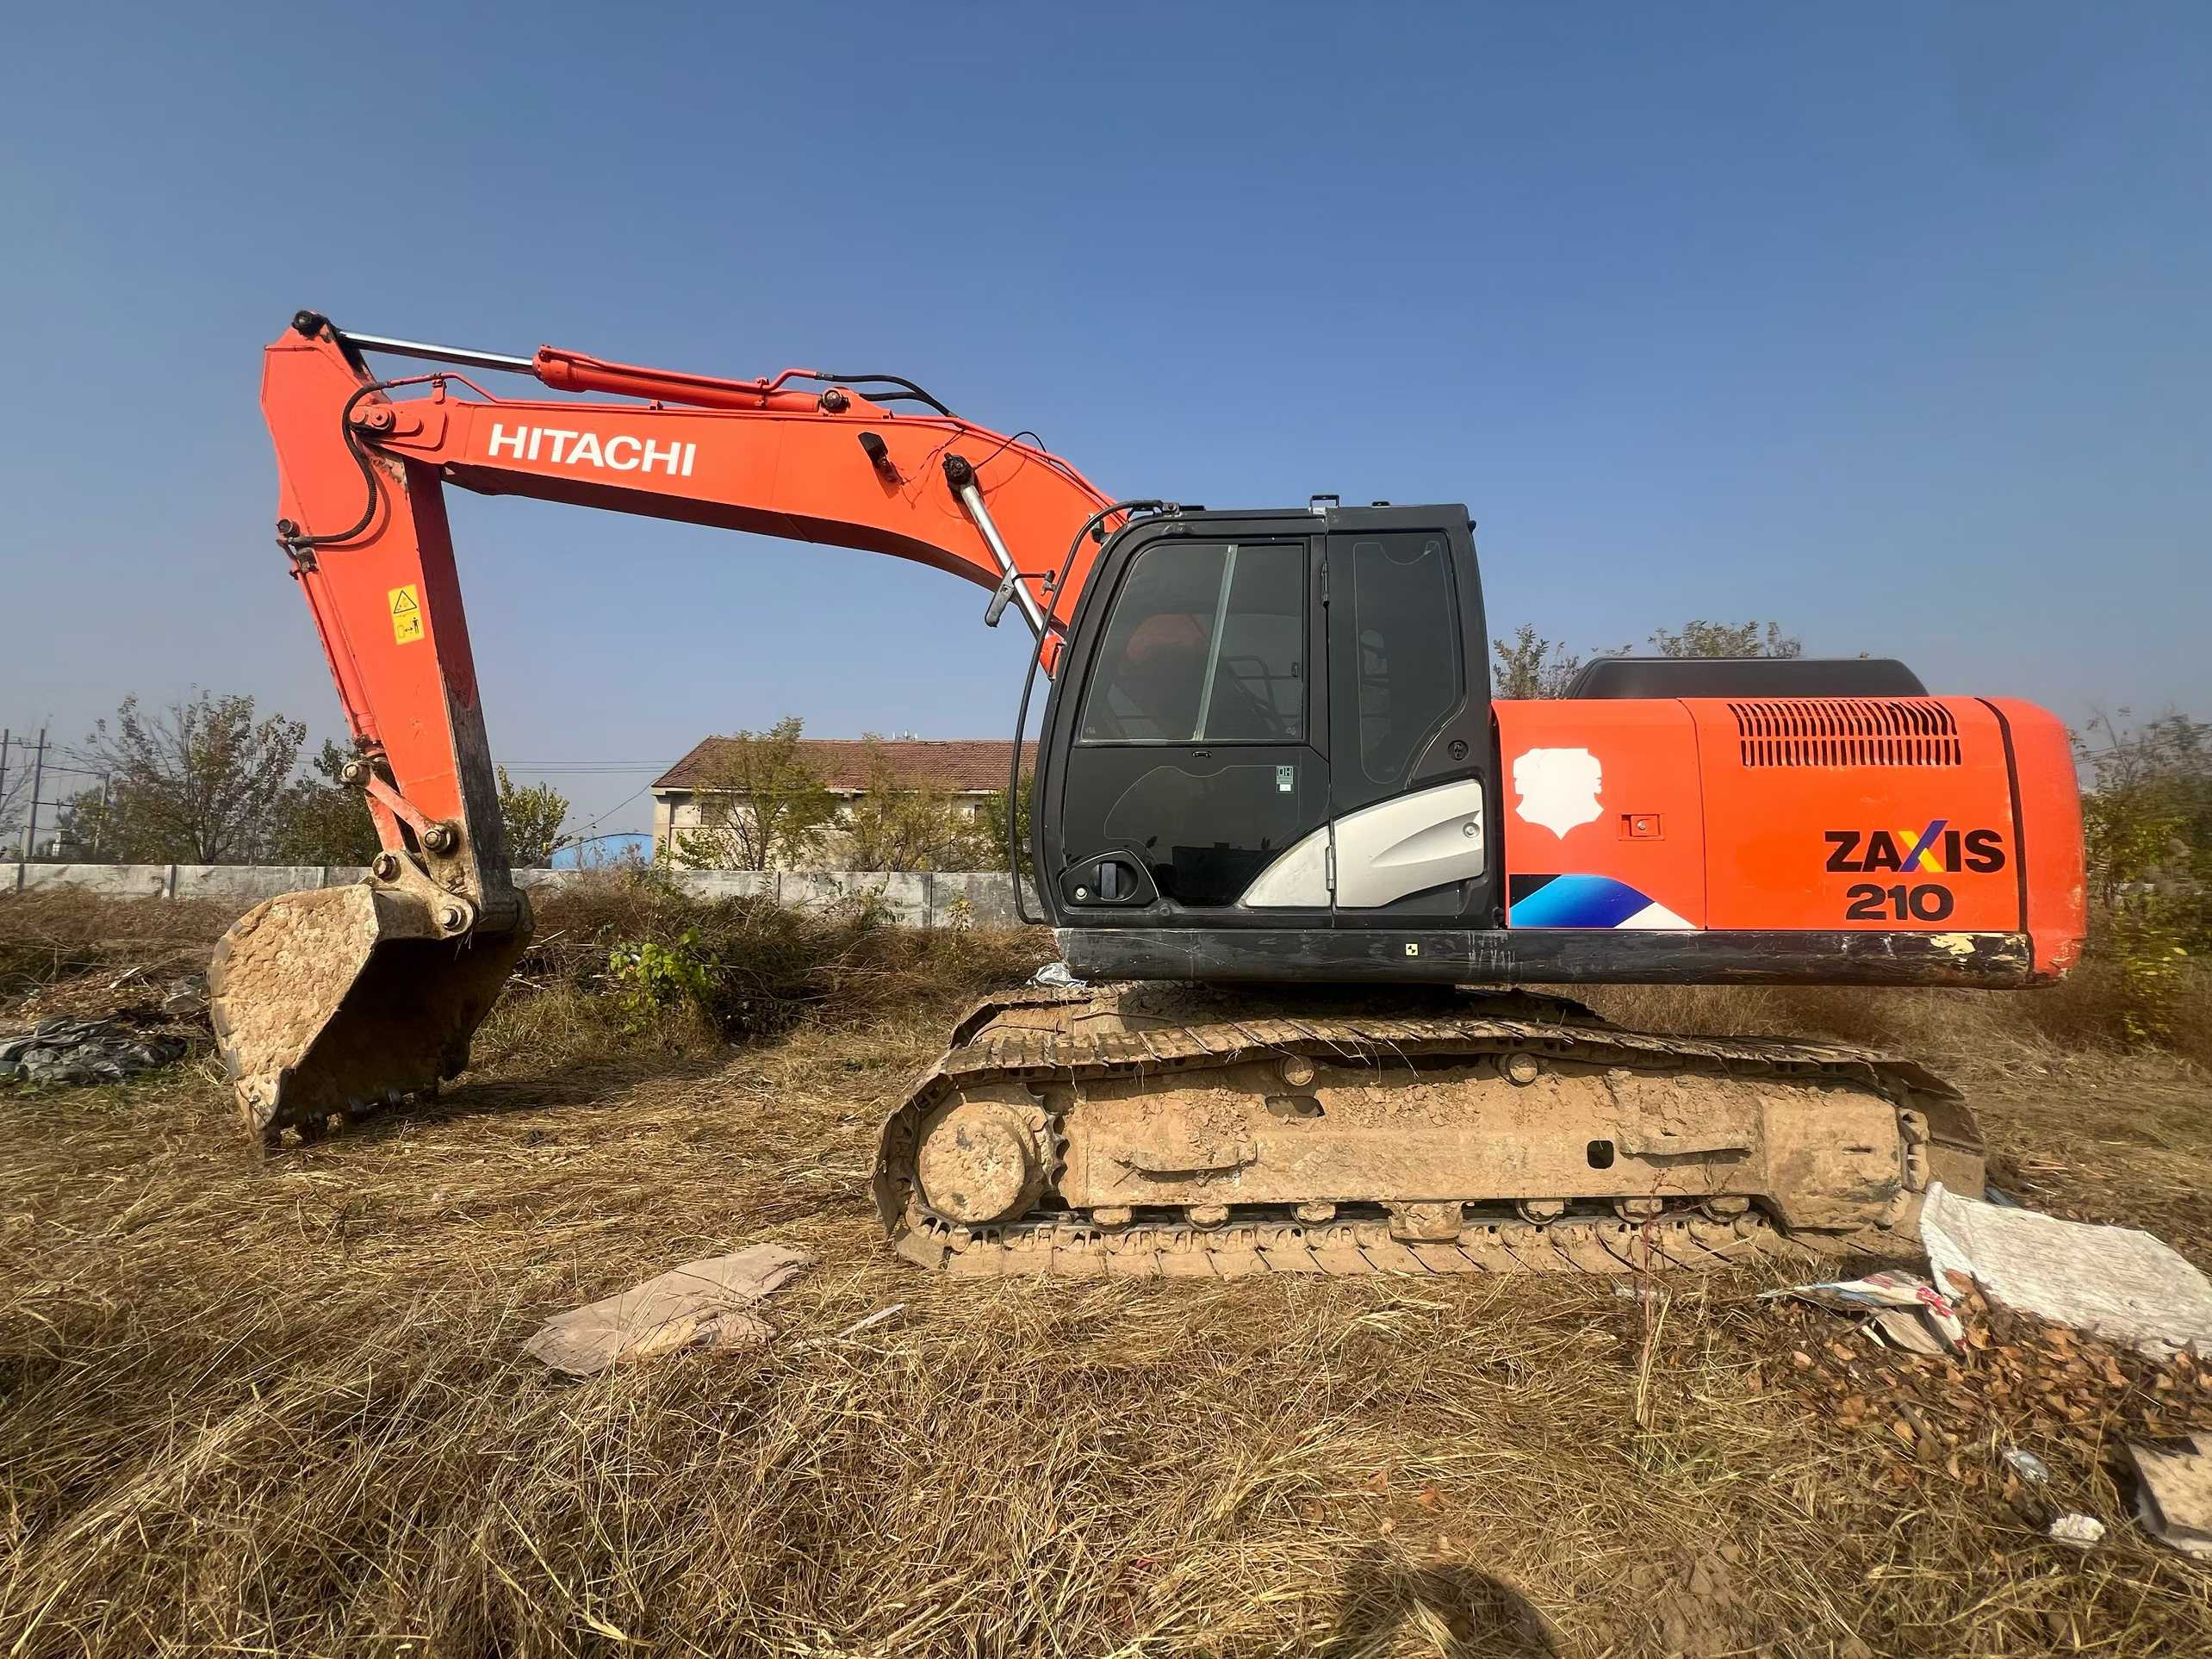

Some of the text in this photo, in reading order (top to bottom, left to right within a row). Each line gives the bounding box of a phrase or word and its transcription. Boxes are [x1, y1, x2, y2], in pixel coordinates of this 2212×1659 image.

[488, 423, 697, 476] HITACHI
[1824, 820, 2006, 873] ZAXIS
[1845, 883, 1954, 922] 210
